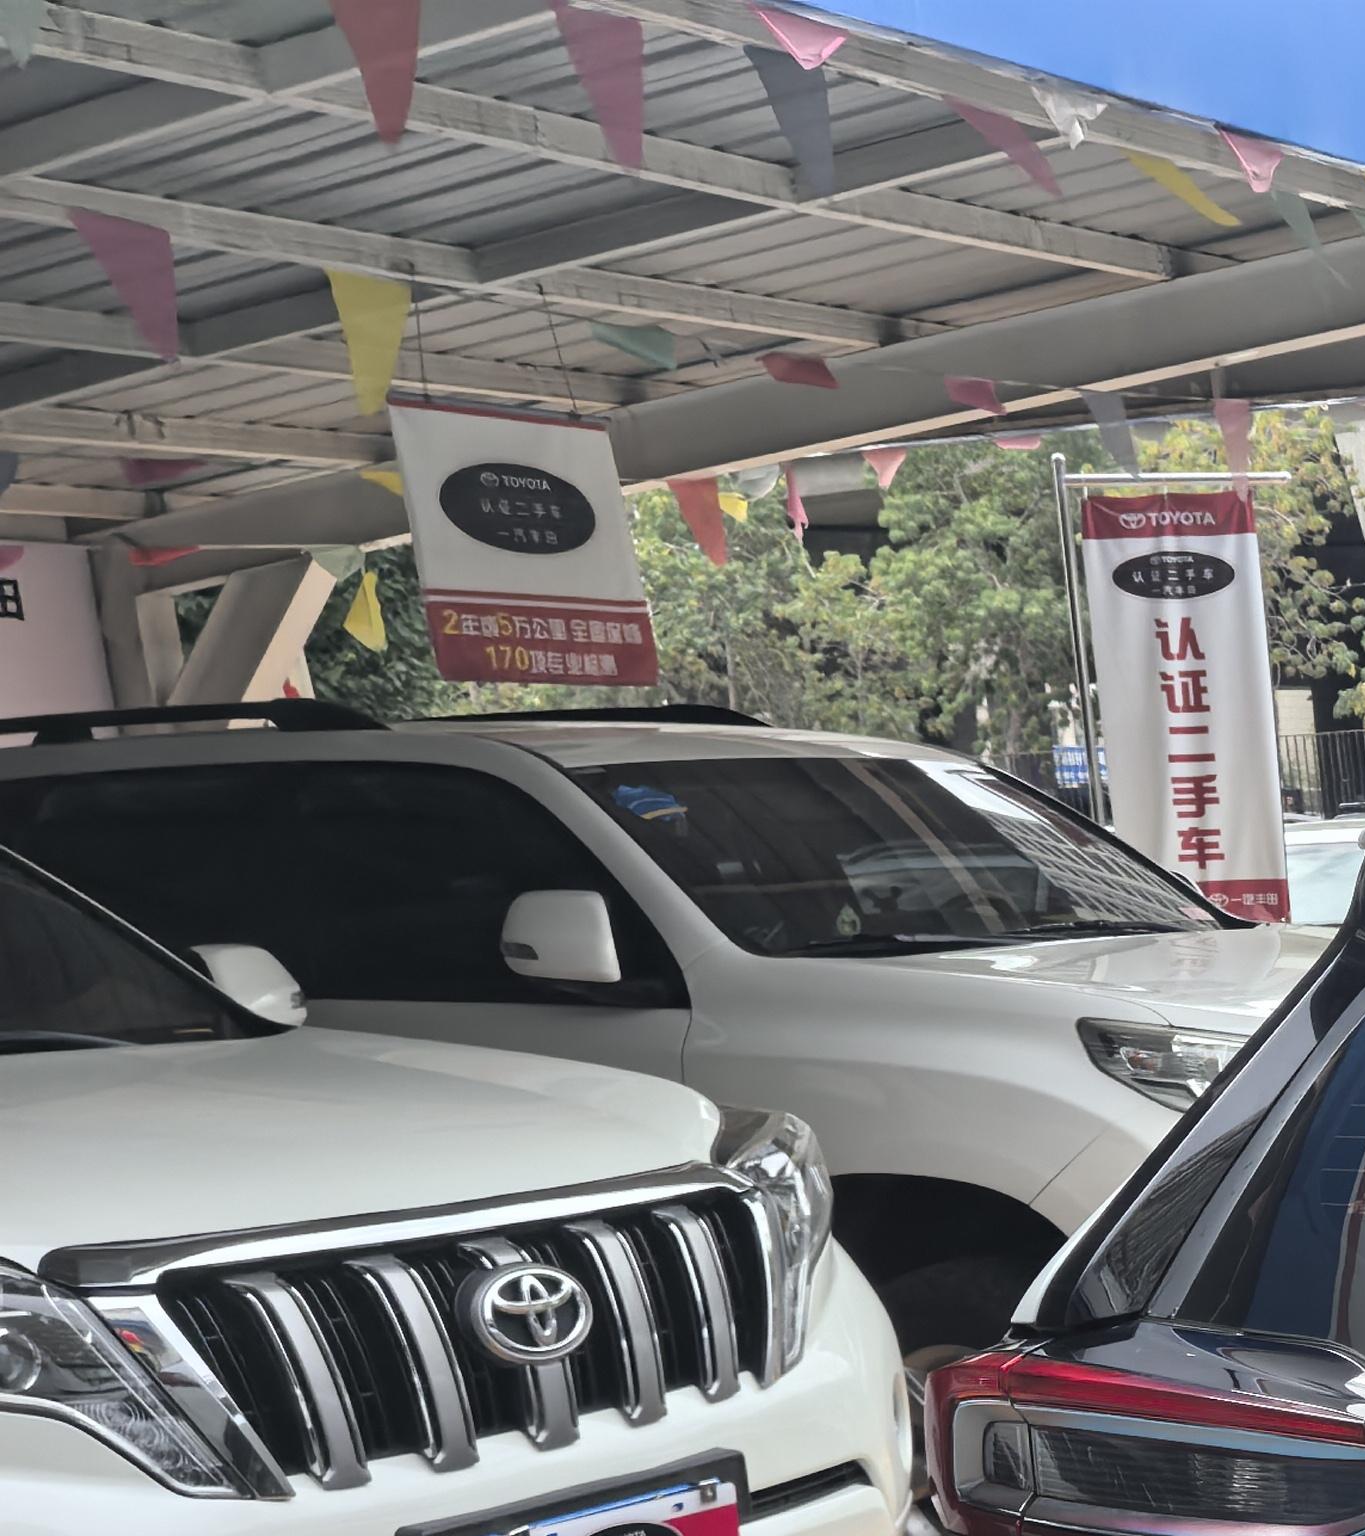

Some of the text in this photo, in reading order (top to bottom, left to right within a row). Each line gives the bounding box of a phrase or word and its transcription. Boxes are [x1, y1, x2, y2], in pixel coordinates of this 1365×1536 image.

[501, 474, 552, 492] TOYOTA
[1146, 511, 1216, 527] TOYOTA
[1132, 568, 1214, 584] 认证二手车
[1154, 617, 1226, 870] 认证二手车
